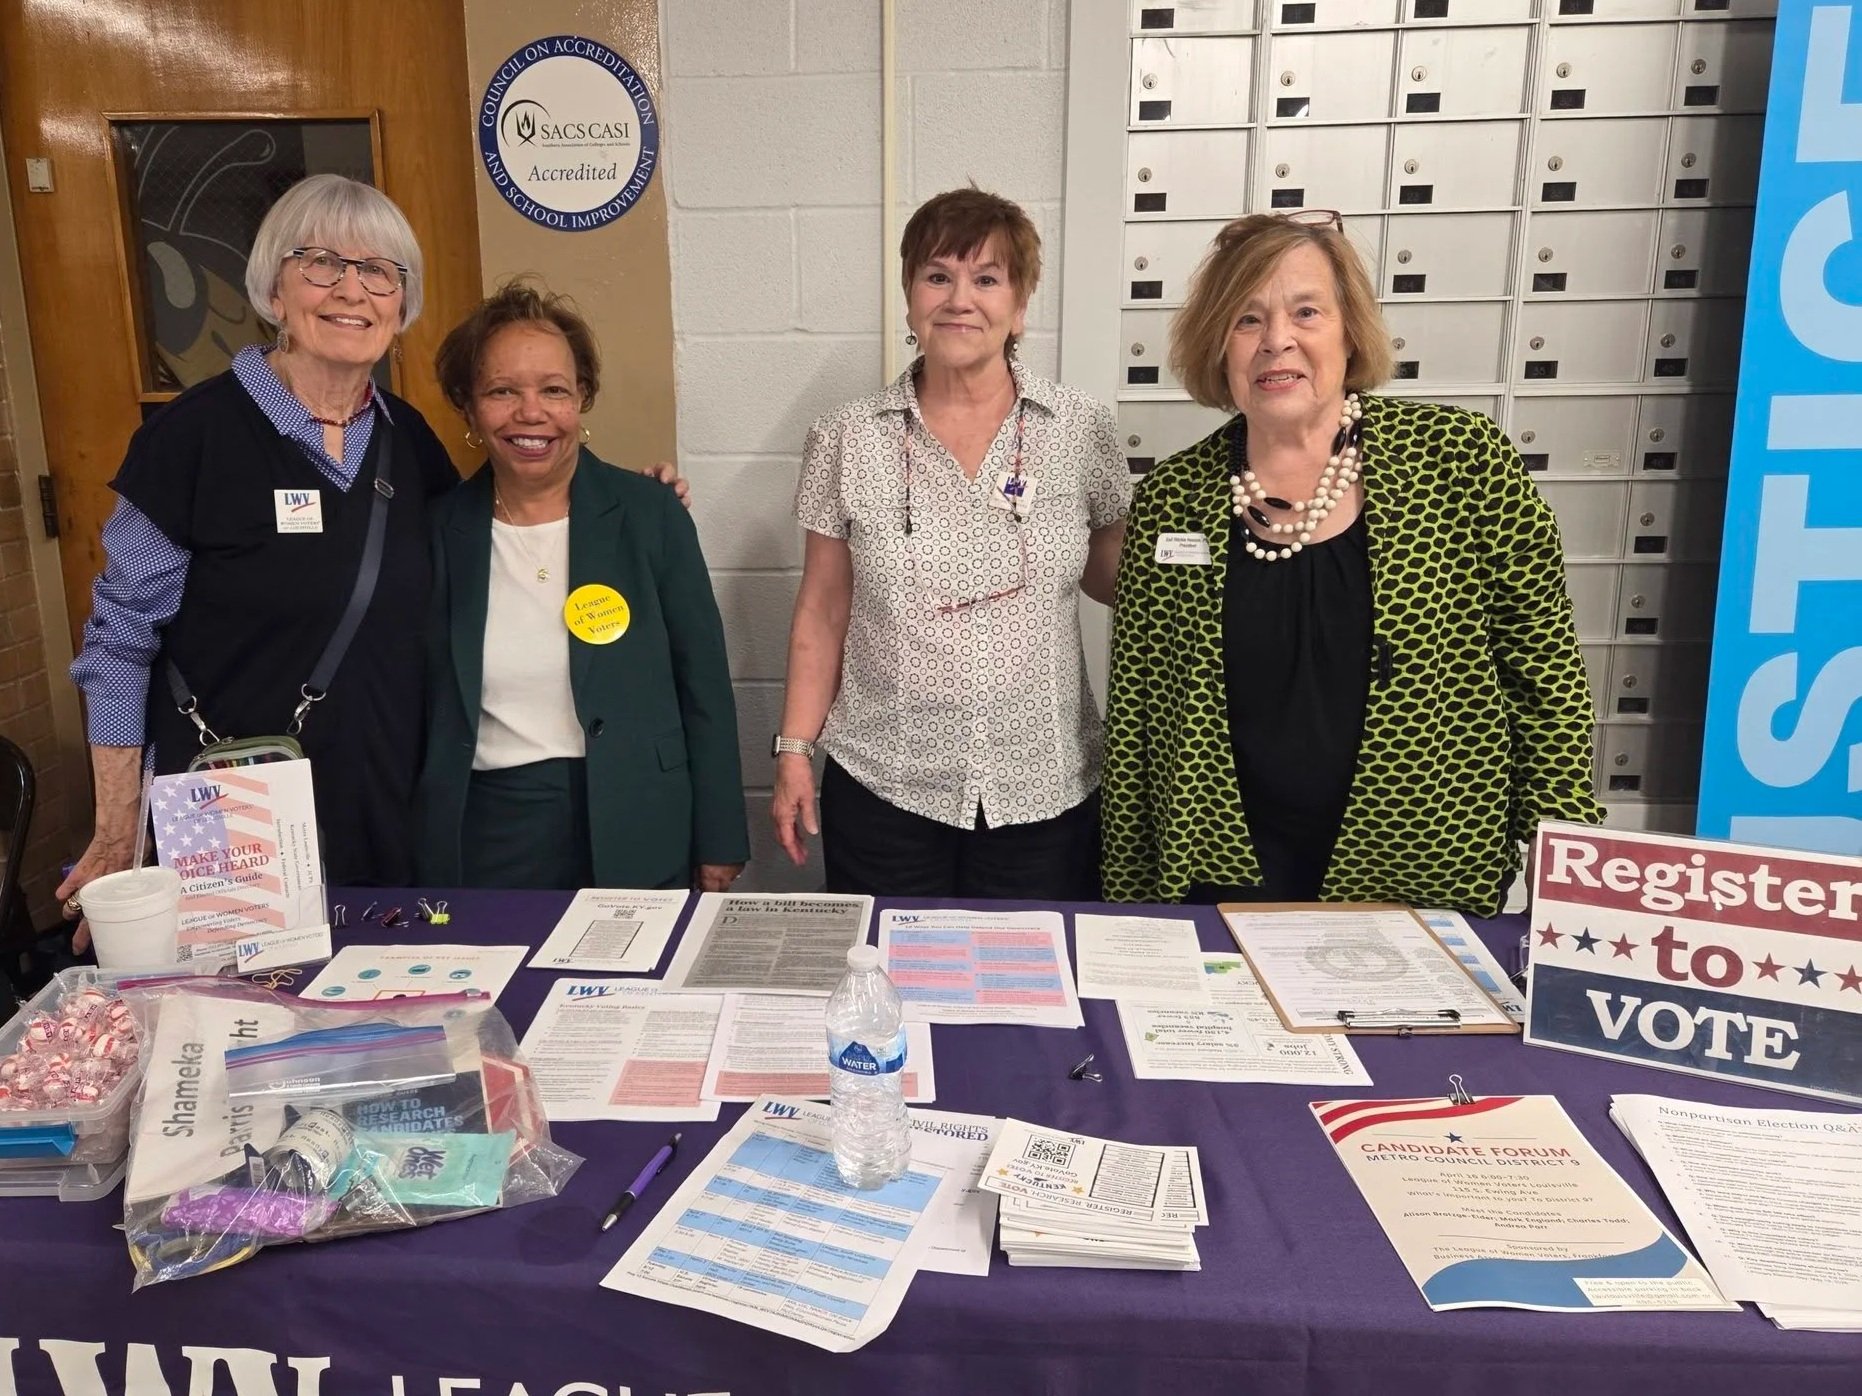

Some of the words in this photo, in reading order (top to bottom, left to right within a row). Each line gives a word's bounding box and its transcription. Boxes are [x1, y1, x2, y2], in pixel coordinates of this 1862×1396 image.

[482, 57, 525, 127] COUNCIL
[525, 42, 550, 61] ON
[554, 39, 655, 125] ACCREDITATION
[541, 123, 586, 140] SACS
[588, 122, 630, 139] CASI
[528, 163, 617, 182] Accredited
[485, 151, 508, 187] AND
[506, 187, 568, 228] SCHOOL
[572, 146, 655, 228] IMPROVEMENT
[284, 493, 310, 505] LWV
[575, 595, 611, 611] League
[574, 615, 585, 626] of
[586, 605, 624, 620] Women
[588, 621, 620, 634] Voters
[191, 785, 221, 802] LWV
[174, 850, 220, 869] MAKE
[221, 843, 262, 859] YOUR
[180, 864, 215, 880] OICE
[218, 855, 270, 874] HEARD
[180, 886, 187, 894] A
[189, 878, 233, 892] Citizen's
[235, 872, 263, 883] Guide
[1546, 838, 1862, 921] Register
[181, 916, 207, 925] LEAGUE
[216, 909, 243, 918] WOMEN
[244, 903, 270, 912] VOTERS
[238, 942, 259, 957] LWV
[1651, 925, 1744, 989] to
[566, 985, 609, 995] LWV
[1585, 989, 1801, 1071] VOTE
[841, 1056, 877, 1071] WATER
[162, 1042, 204, 1137] Shameka
[357, 1100, 398, 1115] HOW
[400, 1097, 421, 1109] TO
[357, 1105, 446, 1126] RESEARCH
[762, 1101, 801, 1117] LWV
[910, 1119, 937, 1129] IVIL
[940, 1122, 989, 1133] RIGHTS
[1658, 1106, 1752, 1126] Nonpartisan
[1757, 1118, 1819, 1131] Election
[220, 1105, 254, 1157] Parris
[1361, 1143, 1486, 1157] CANDIDATE
[1491, 1147, 1572, 1158] FORUM
[398, 1147, 428, 1179] Ones
[417, 1148, 447, 1180] Wet
[1424, 1156, 1493, 1165] COUNCIL
[1013, 1173, 1067, 1190] KENTUCKY
[1443, 1192, 1491, 1201] important
[1506, 1244, 1555, 1252] Sponsored
